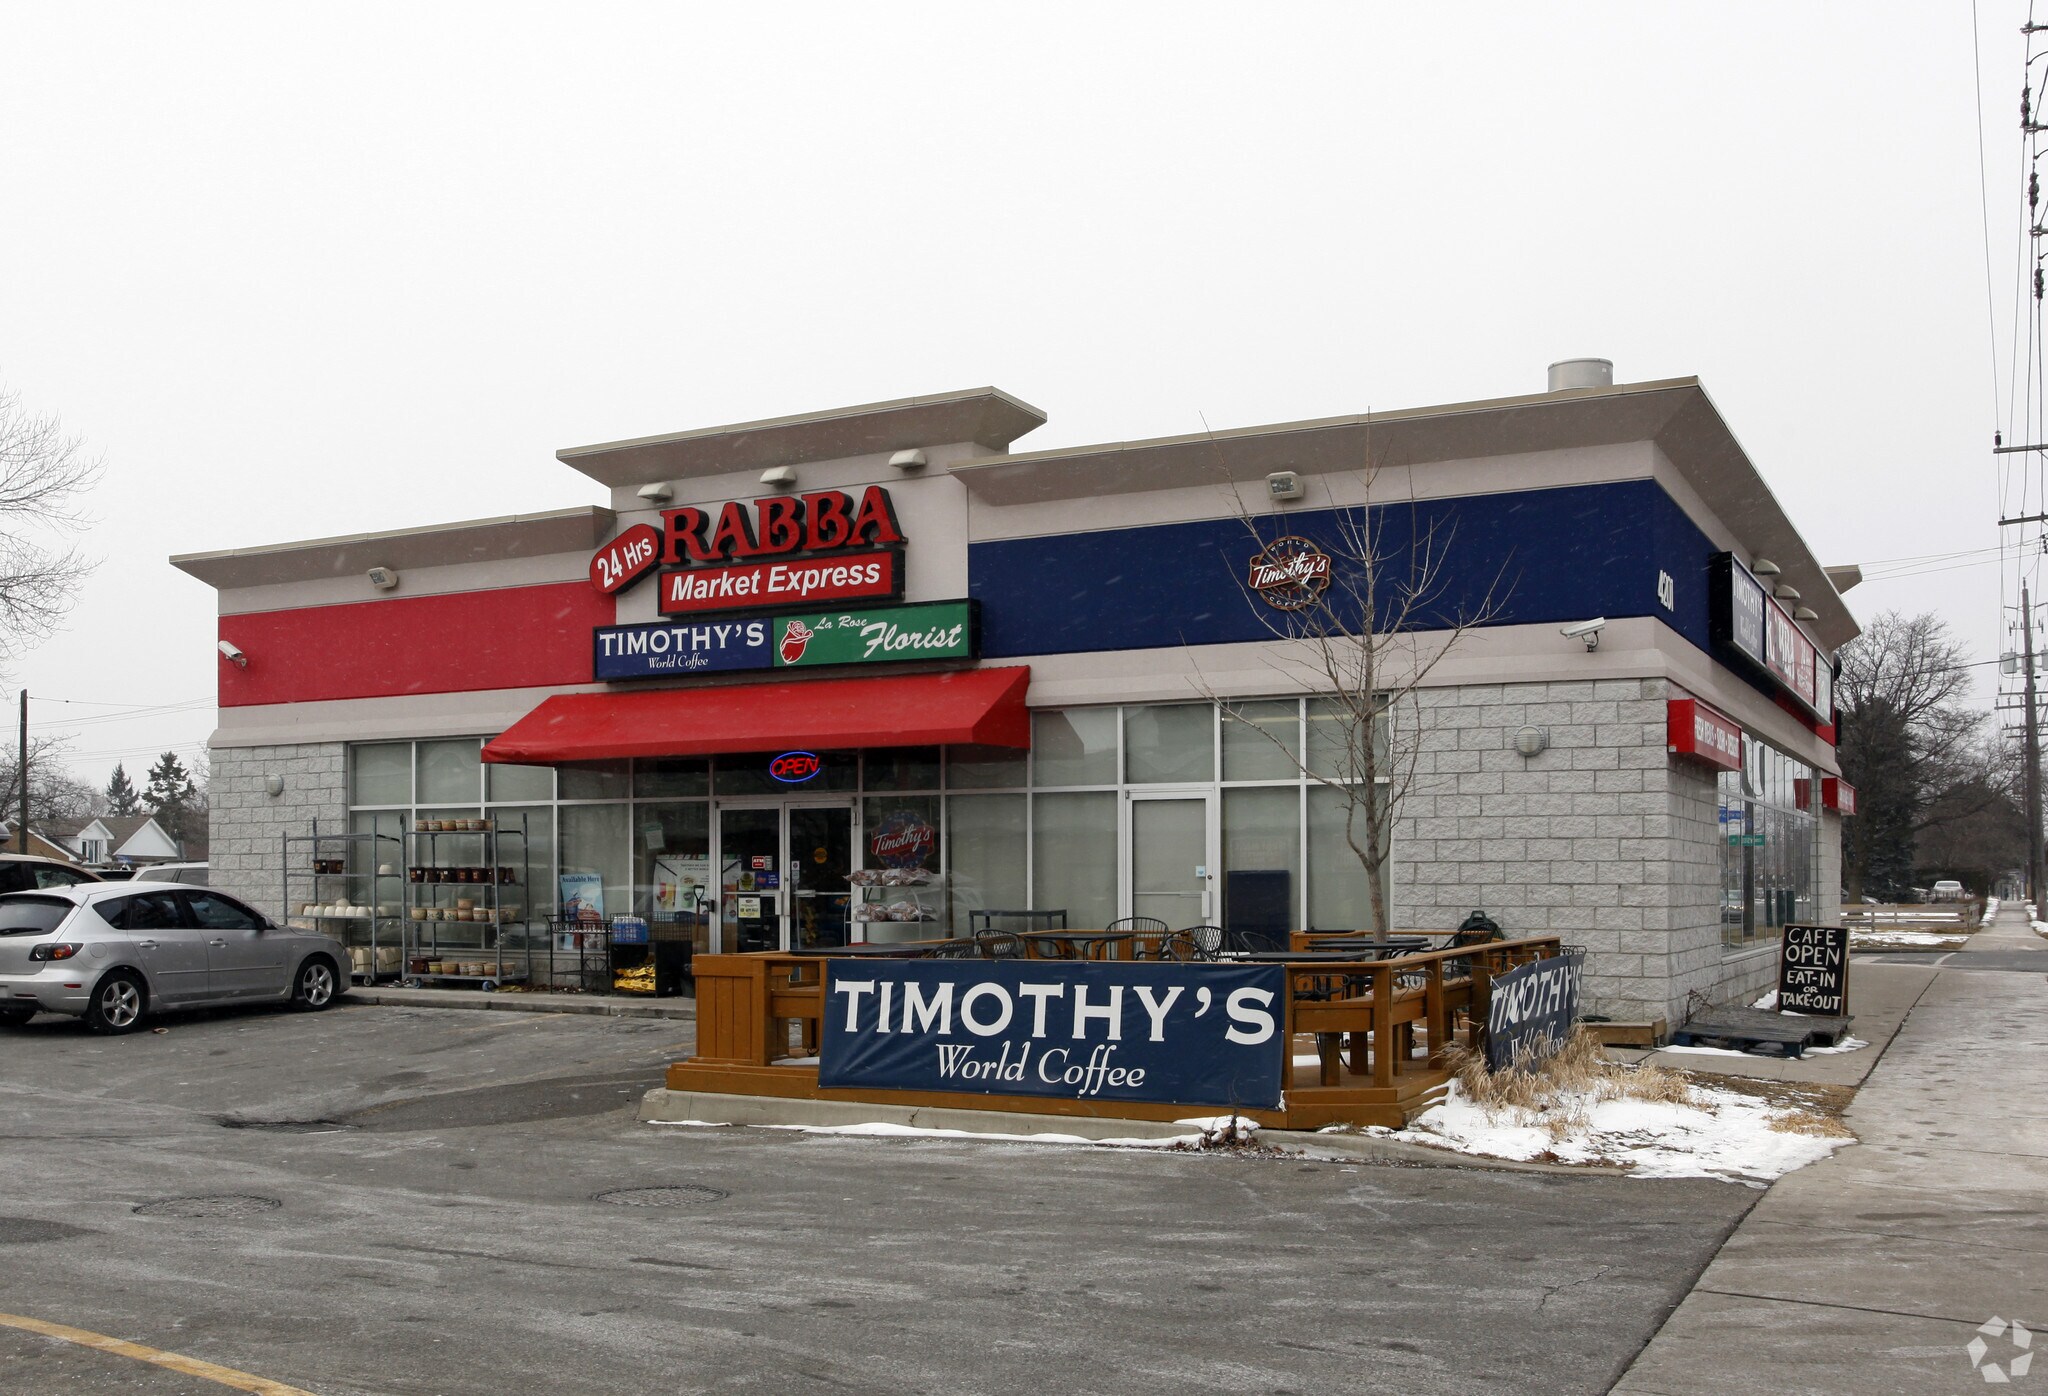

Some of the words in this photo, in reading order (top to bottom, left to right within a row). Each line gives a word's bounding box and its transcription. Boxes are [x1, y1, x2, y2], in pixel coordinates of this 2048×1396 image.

[659, 485, 902, 565] RABBA
[597, 548, 623, 588] 24
[623, 538, 652, 570] Hrs
[671, 571, 761, 602] Market
[767, 562, 881, 596] Express
[1657, 569, 1674, 612] 4201
[814, 617, 833, 630] La
[839, 615, 868, 629] Rose
[600, 622, 765, 656] TIMOTHY'S
[859, 622, 963, 659] Florist
[648, 654, 676, 669] World
[677, 652, 709, 670] Coffee
[771, 755, 820, 775] OPEN
[873, 823, 931, 855] Timothy's
[1788, 927, 1837, 946] CAFE
[1785, 944, 1840, 966] OPEN
[1786, 970, 1836, 988] EAT-IN
[1803, 986, 1819, 994] OR
[834, 978, 1276, 1046] TIMOTHY'S
[1780, 991, 1842, 1010] TAKE-OUT
[935, 1040, 1032, 1082] World
[1038, 1044, 1146, 1096] Coffee
